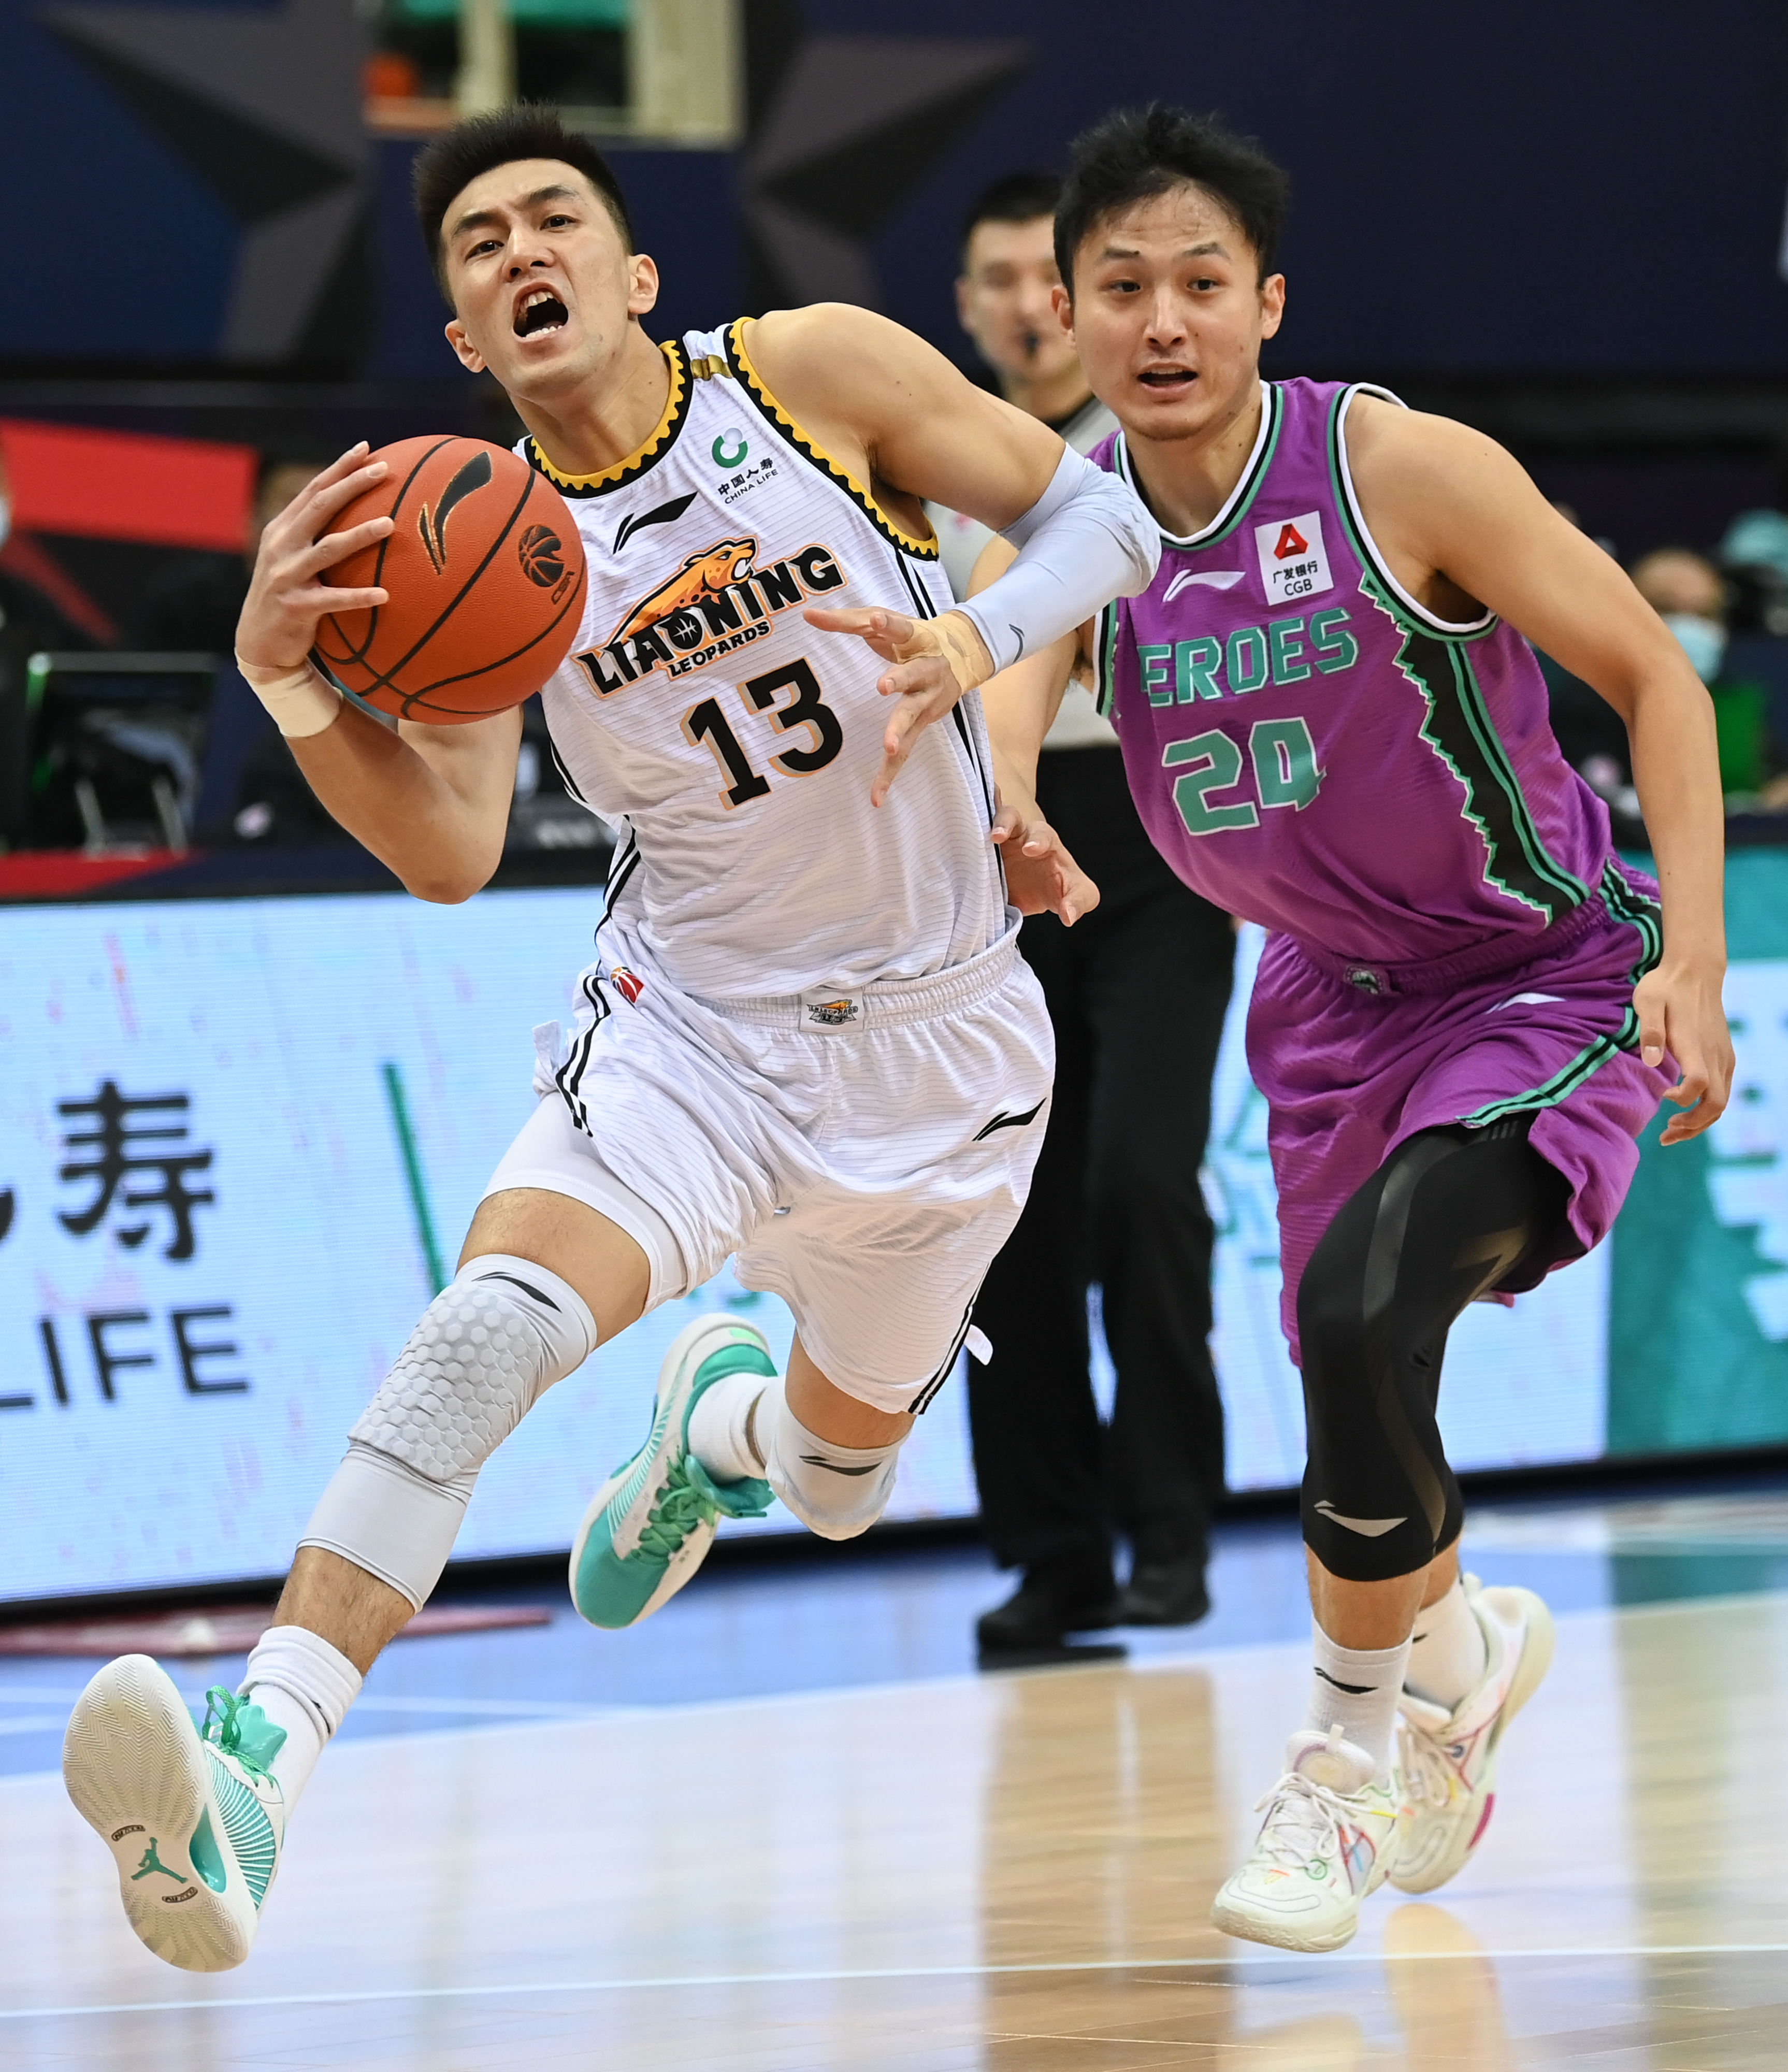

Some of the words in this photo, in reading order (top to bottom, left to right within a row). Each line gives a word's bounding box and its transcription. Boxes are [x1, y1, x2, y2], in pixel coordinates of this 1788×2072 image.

[717, 457, 773, 496] 中国人寿
[724, 483, 756, 505] CHINA
[756, 468, 779, 485] LIFE
[1272, 560, 1319, 584] 广发银行
[1284, 578, 1313, 596] CGB
[573, 544, 846, 696] LIAONING
[667, 620, 770, 678] LEOPARDS
[1136, 607, 1359, 708] EROES
[680, 656, 843, 811] 13
[0, 1078, 214, 1262] 寿
